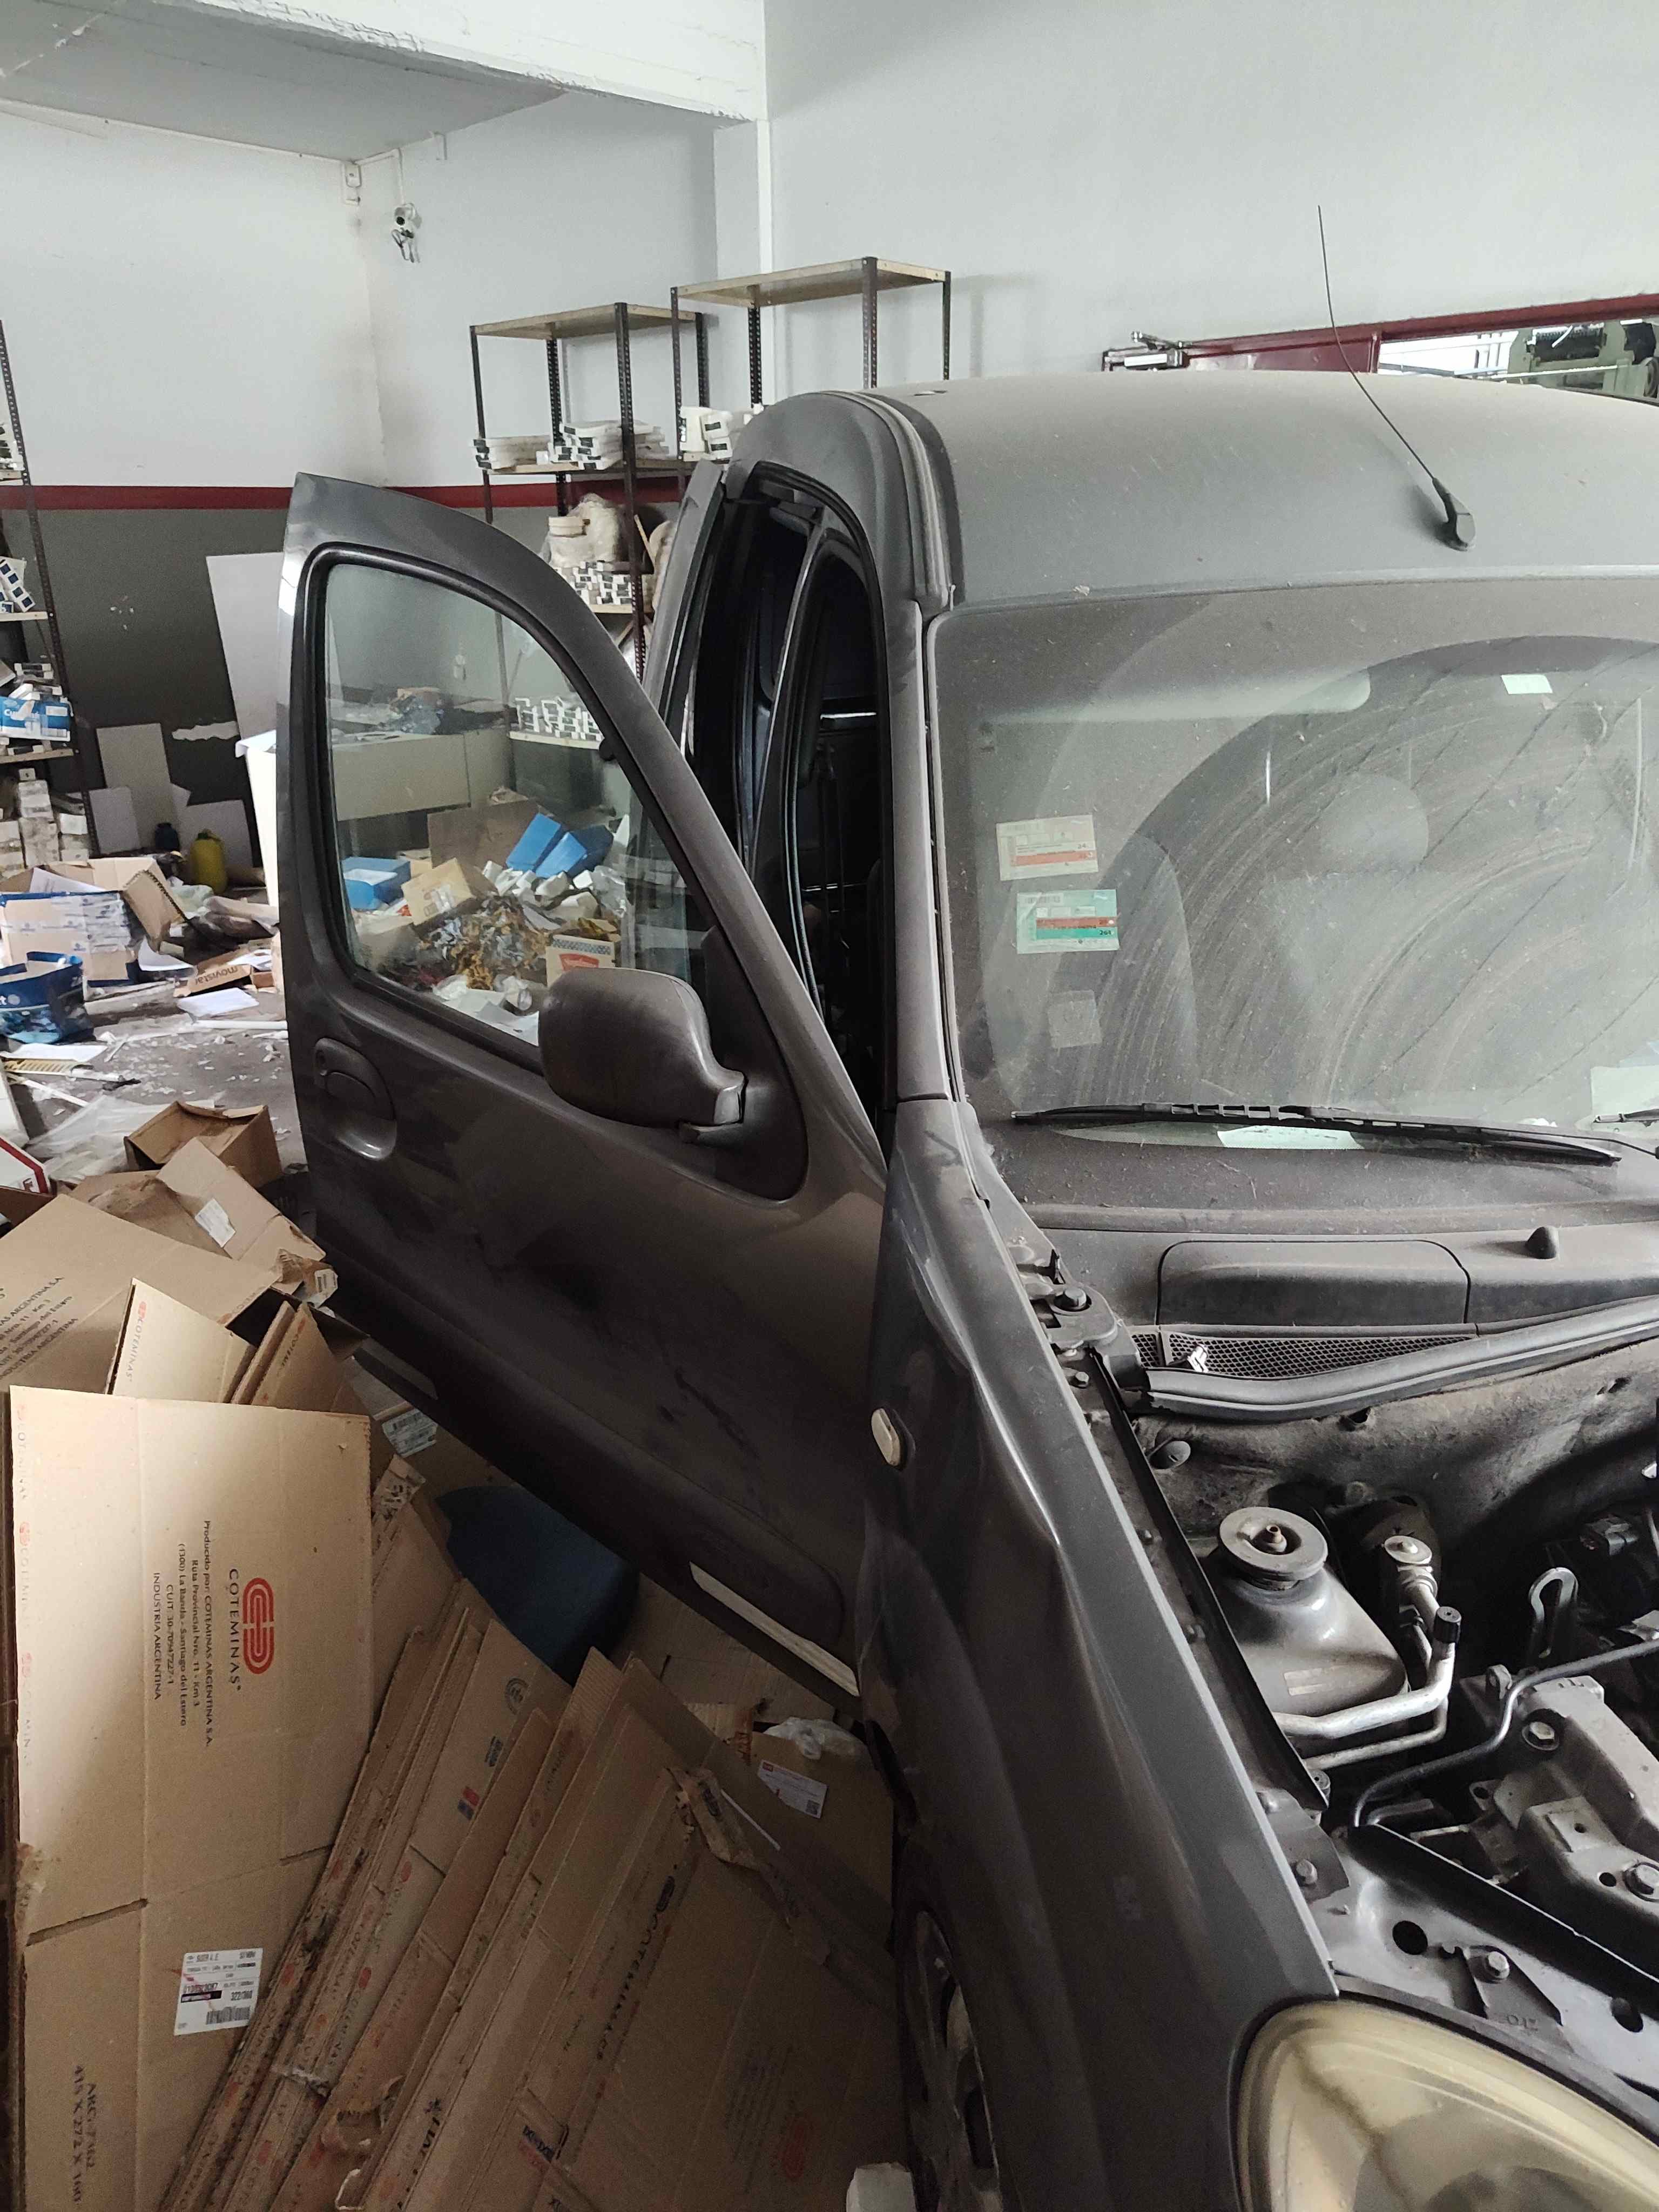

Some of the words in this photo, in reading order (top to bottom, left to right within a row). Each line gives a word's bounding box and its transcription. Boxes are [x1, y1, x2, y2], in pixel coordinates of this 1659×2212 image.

[125, 1316, 145, 1379] COTEMINAS
[204, 1520, 212, 1571] Producido
[153, 1572, 161, 1632] INDUSTRIA
[179, 1575, 186, 1586] La
[192, 1584, 200, 1634] Provincial
[205, 1595, 213, 1659] COTEMINAS
[228, 1568, 242, 1684] COTEMINAS
[179, 1628, 187, 1672] Santiago
[193, 1682, 200, 1698] Km
